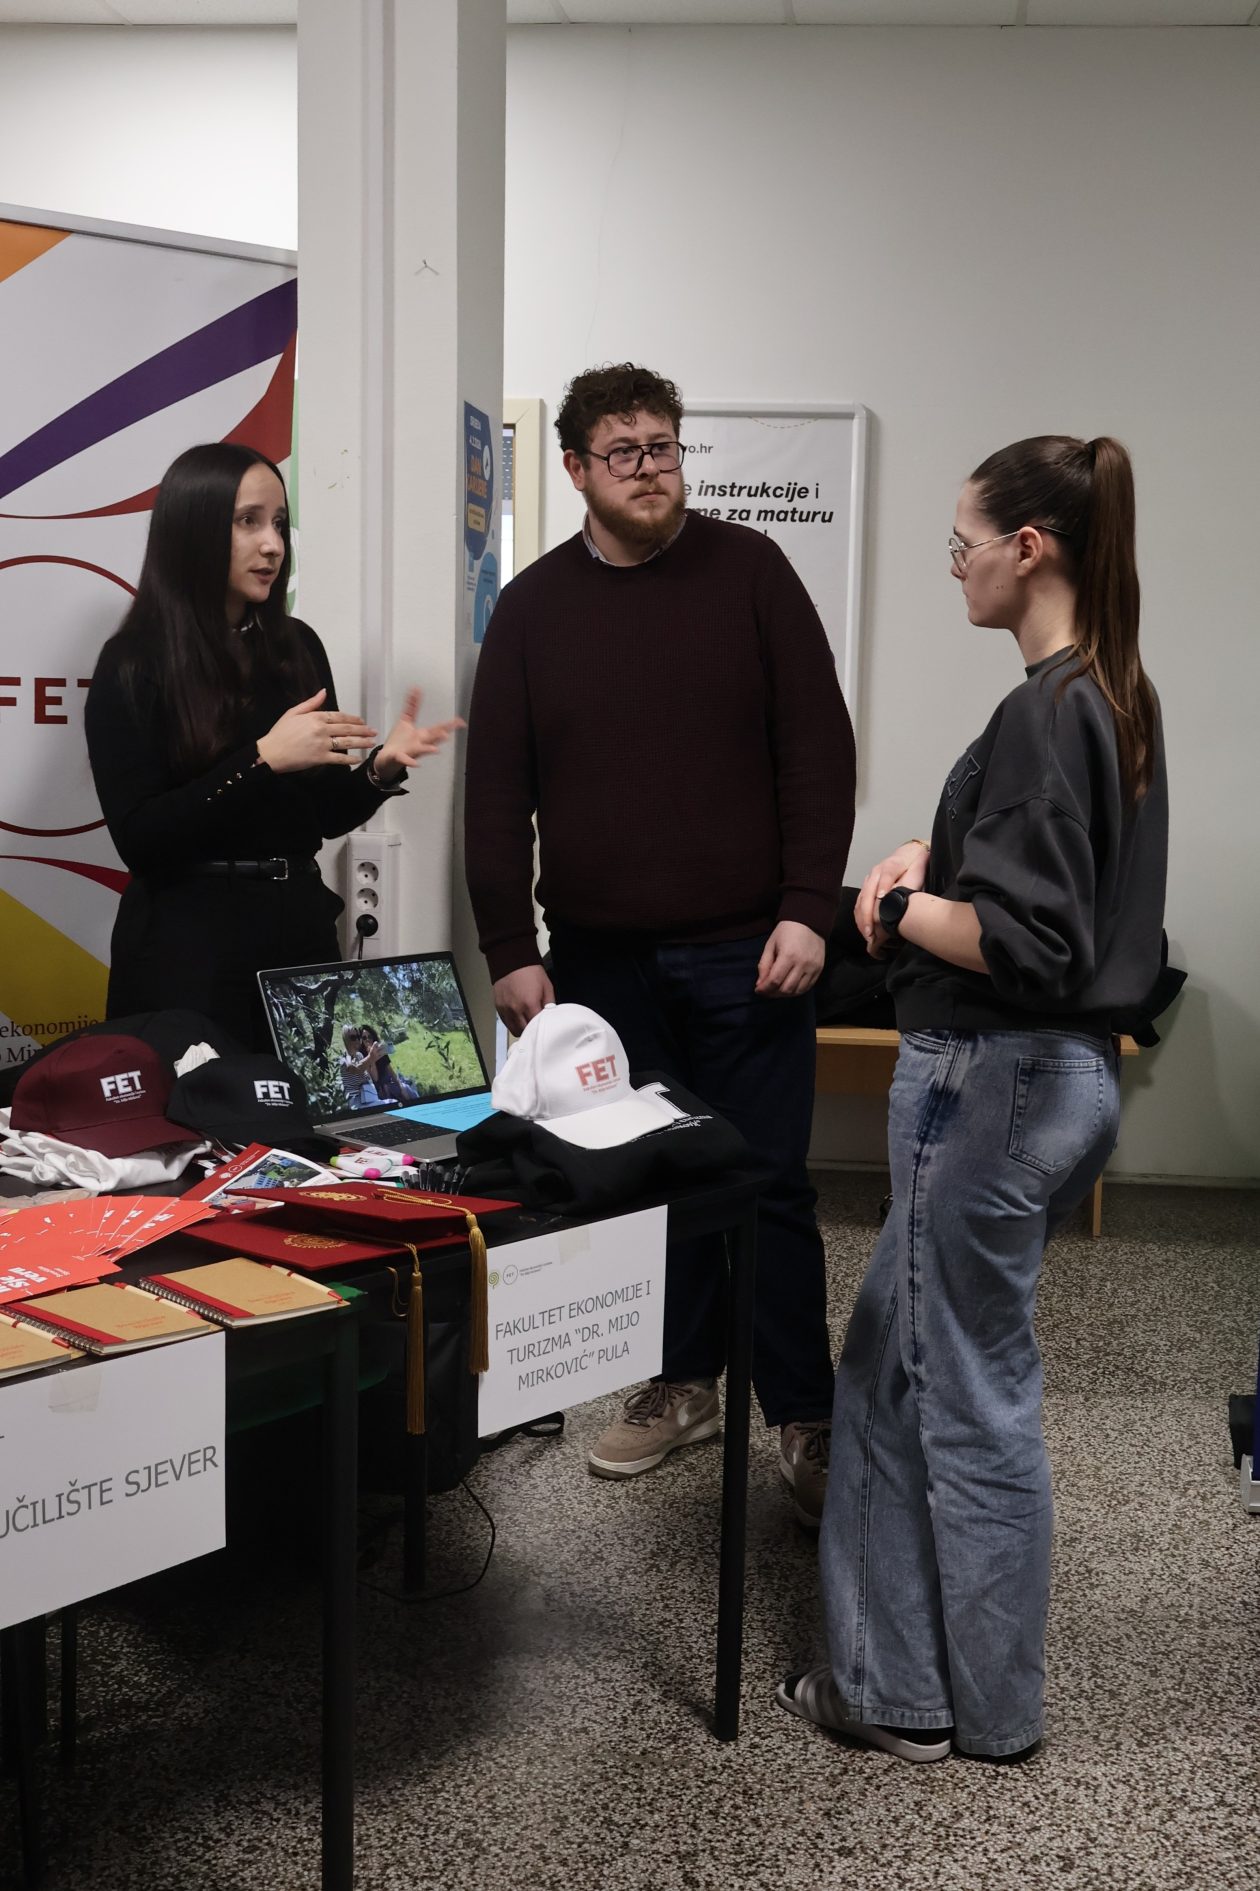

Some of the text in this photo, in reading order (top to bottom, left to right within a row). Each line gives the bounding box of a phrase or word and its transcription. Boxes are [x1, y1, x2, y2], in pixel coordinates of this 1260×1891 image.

[698, 480, 810, 502] instrukcije
[815, 483, 820, 499] i
[726, 508, 752, 521] za
[756, 507, 834, 523] maturu
[100, 1070, 142, 1098] FET
[575, 1055, 616, 1086] FET
[254, 1080, 291, 1100] FET
[495, 1280, 651, 1341] FAKULTET EKONOMIJE I
[507, 1332, 572, 1365] TURIZMA
[608, 1311, 640, 1334] MIJO
[598, 1341, 630, 1364] PULA
[124, 1445, 219, 1497] SJEVER
